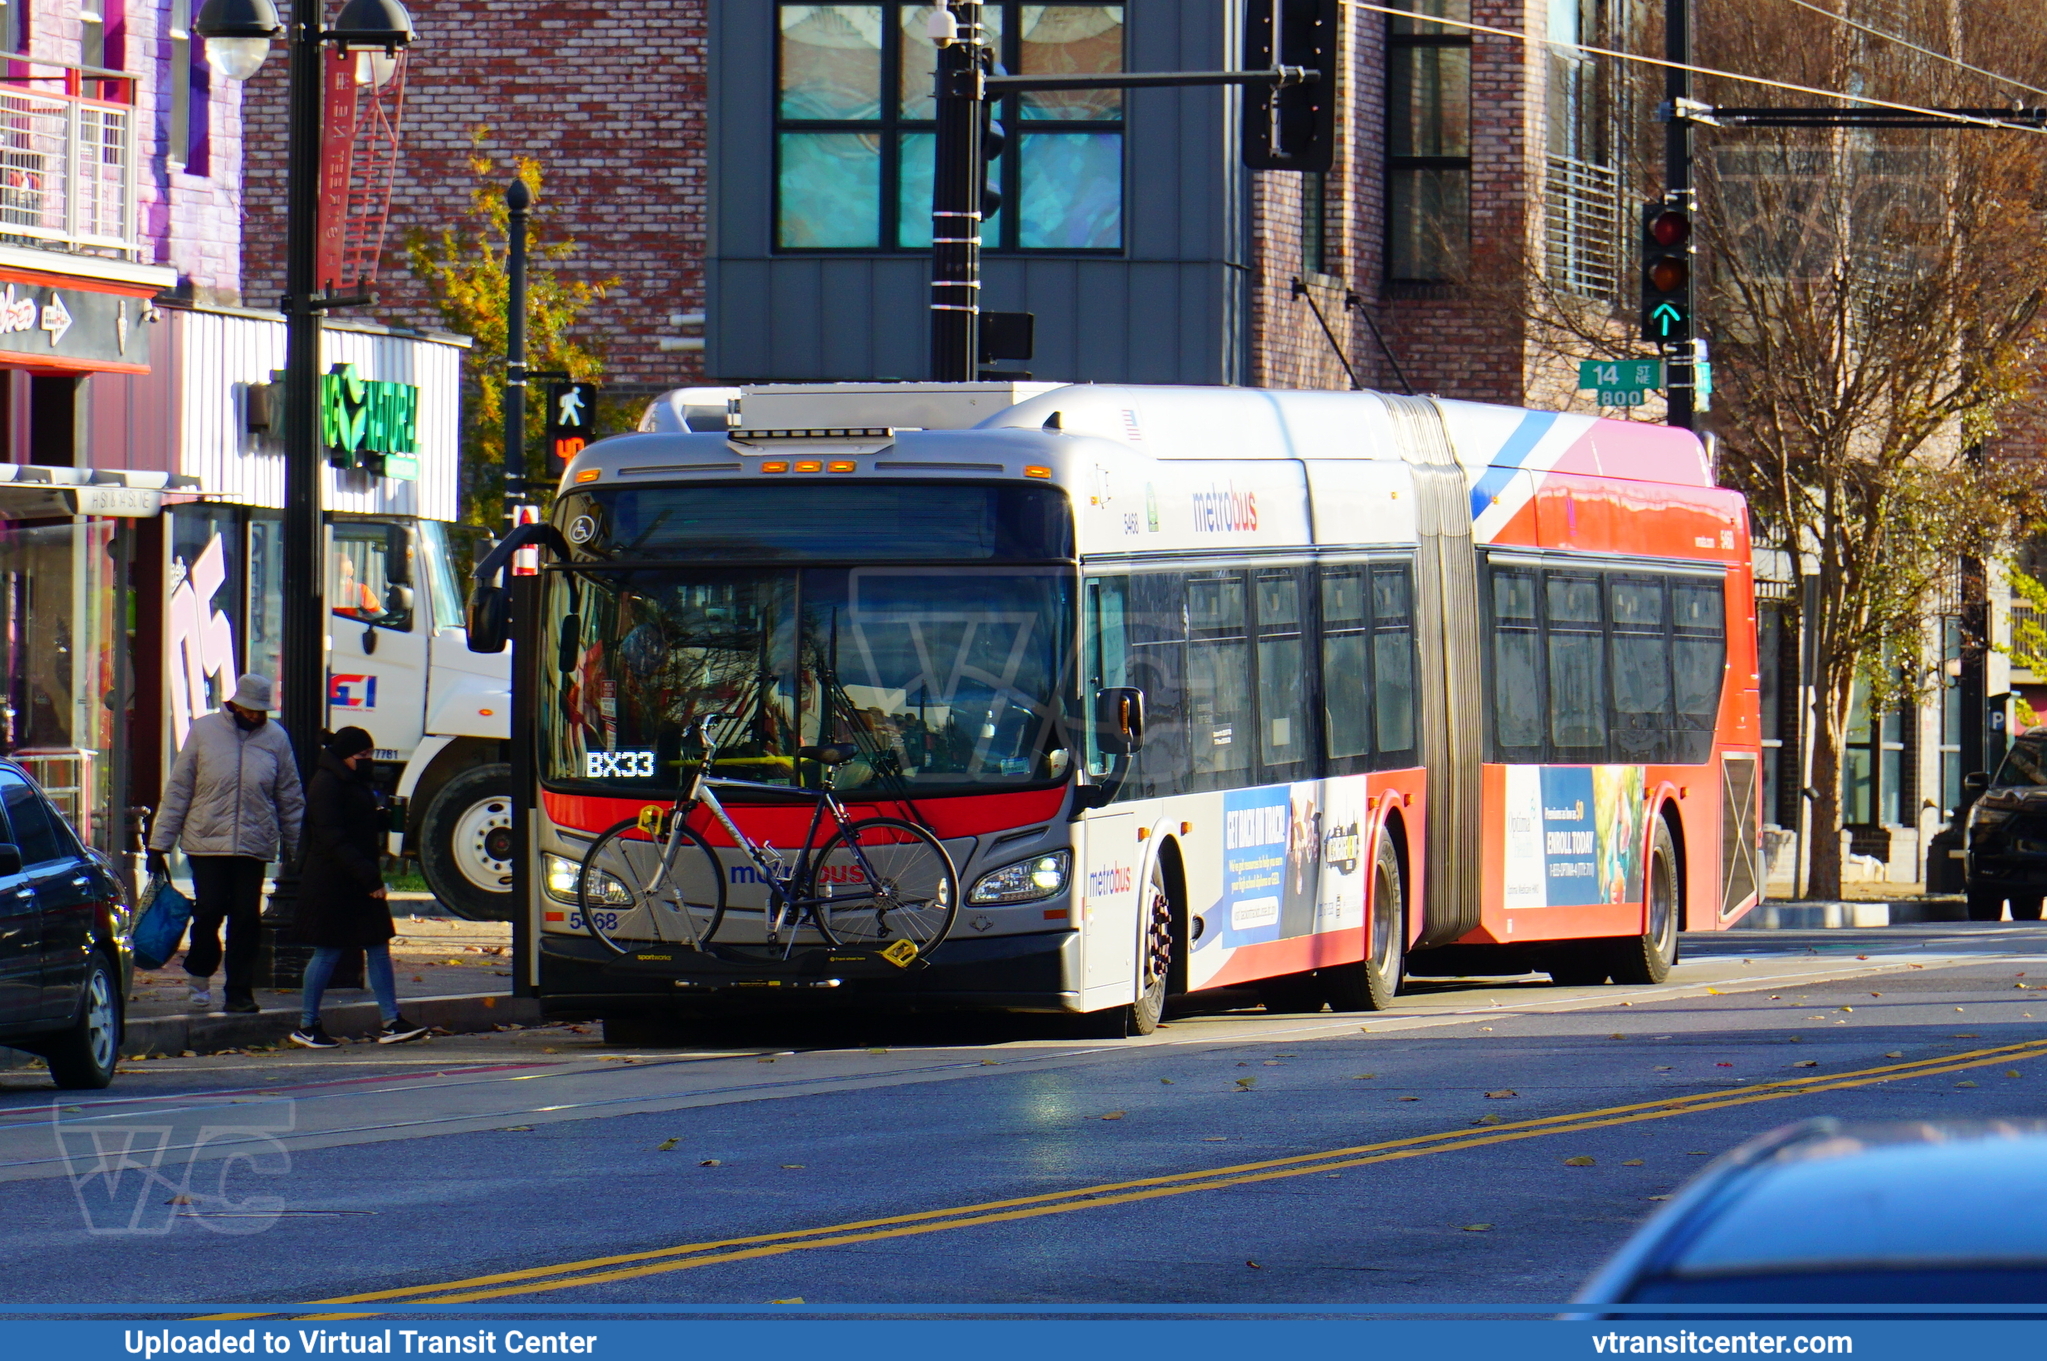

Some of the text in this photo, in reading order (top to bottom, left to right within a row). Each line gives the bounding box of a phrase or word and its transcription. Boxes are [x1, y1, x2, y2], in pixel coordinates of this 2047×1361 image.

[1592, 365, 1650, 385] 14 ST
[1635, 375, 1650, 385] NE
[1601, 390, 1641, 405] 800
[92, 492, 99, 509] H
[1193, 479, 1258, 532] metrobus
[1124, 512, 1140, 535] 5468
[1992, 711, 2005, 729] P
[586, 751, 655, 777] BX33
[1547, 830, 1594, 854] ENROLL TODAY
[1090, 860, 1131, 897] metrobus
[637, 953, 672, 961] sportworks
